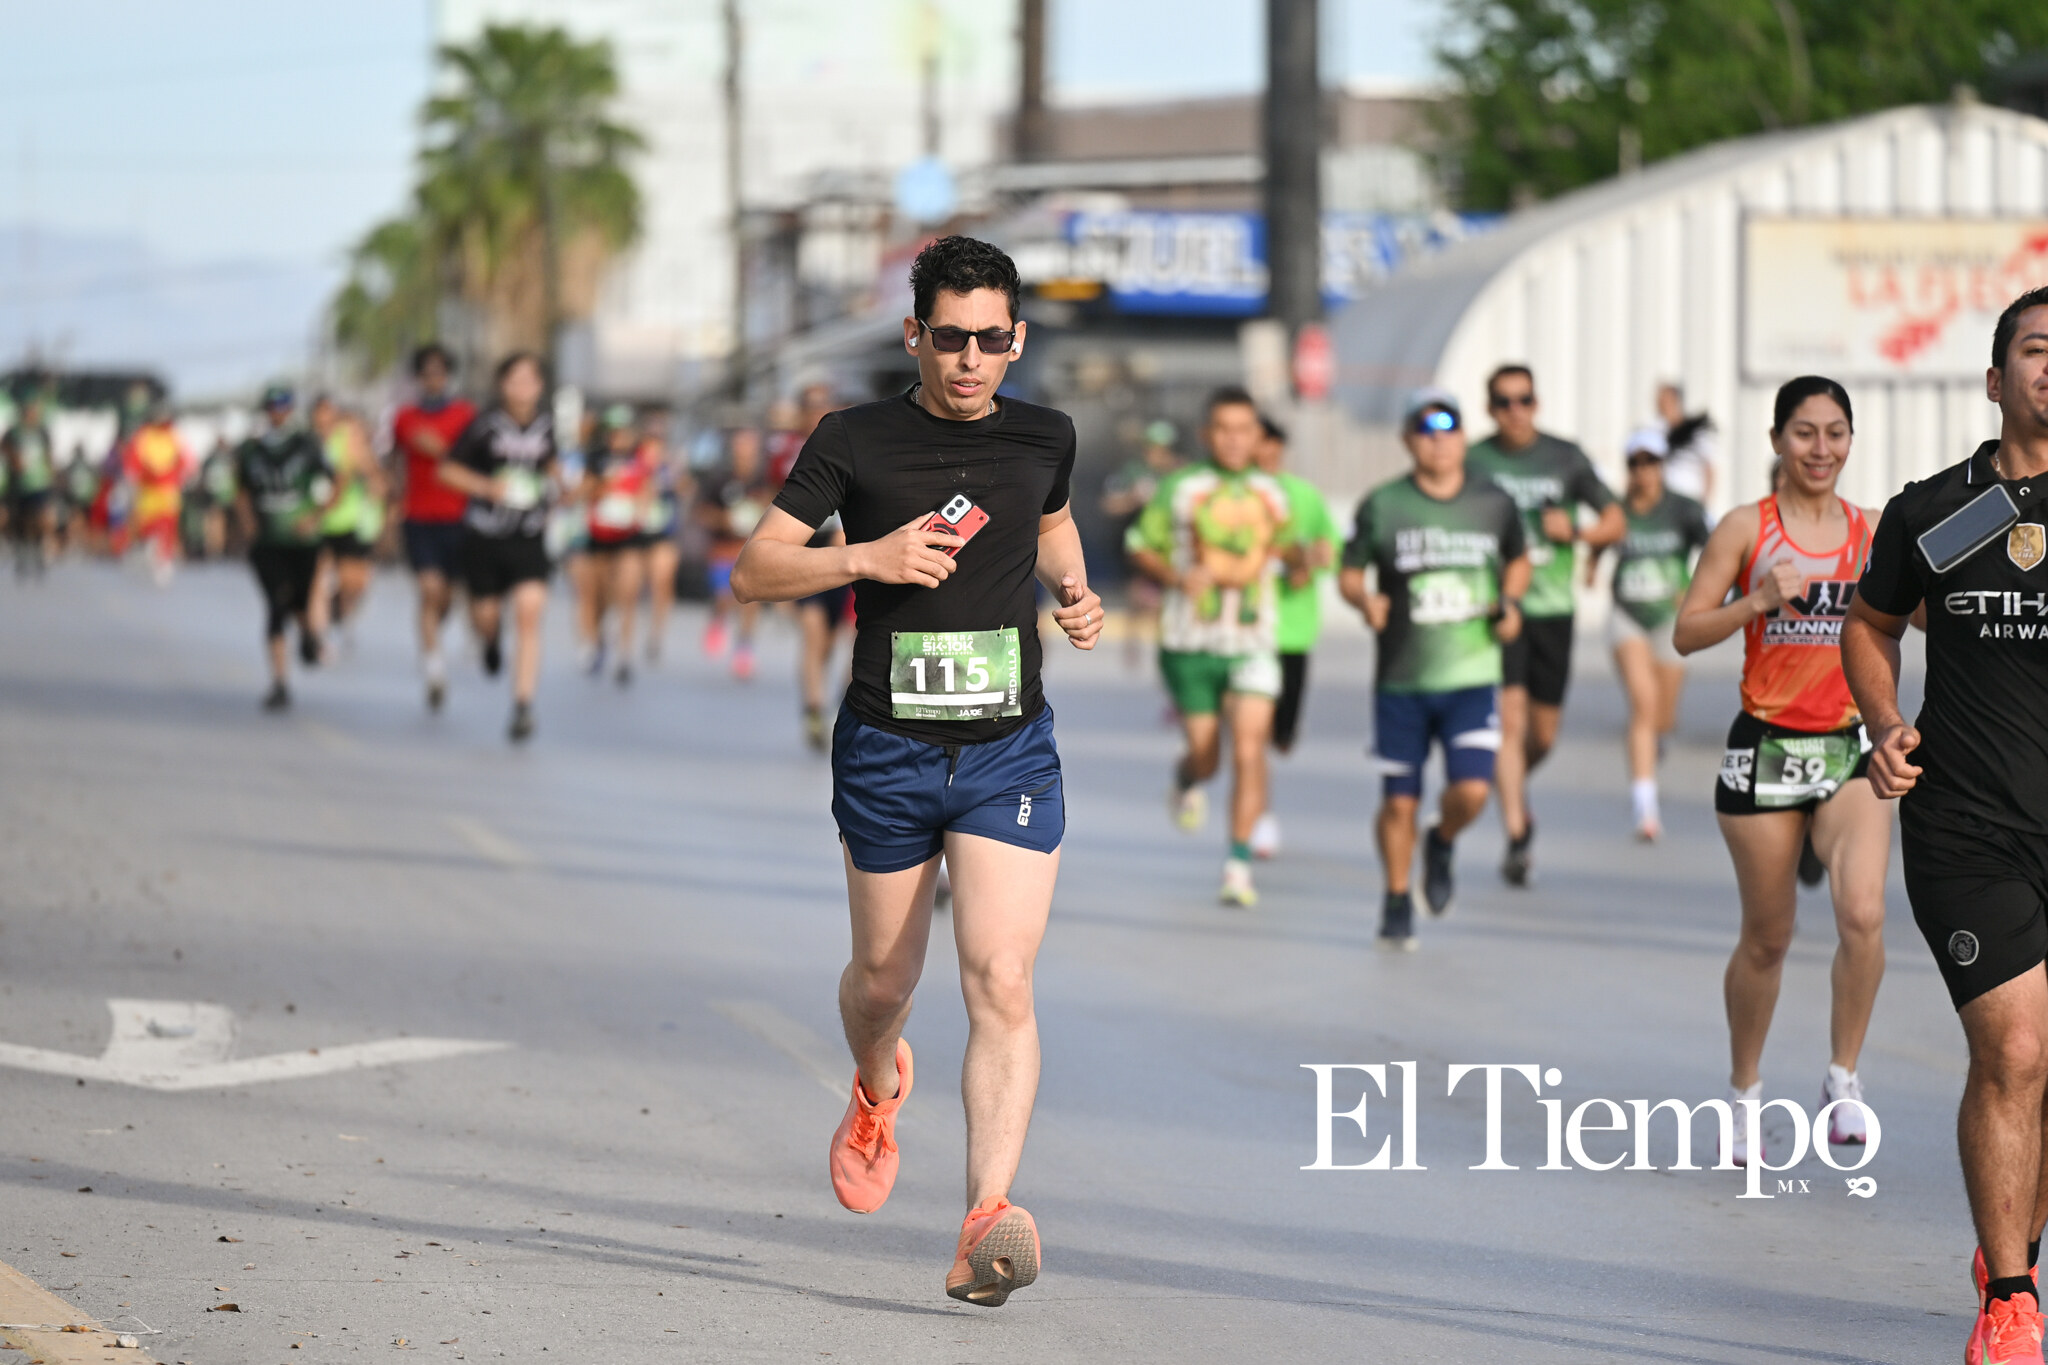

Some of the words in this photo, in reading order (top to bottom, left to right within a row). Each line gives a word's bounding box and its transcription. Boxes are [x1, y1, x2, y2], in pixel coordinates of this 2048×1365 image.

[922, 634, 974, 642] CARRERA
[1005, 634, 1017, 643] 115
[909, 656, 990, 692] 115
[1008, 647, 1017, 706] MEDALLA
[1781, 756, 1826, 785] 59
